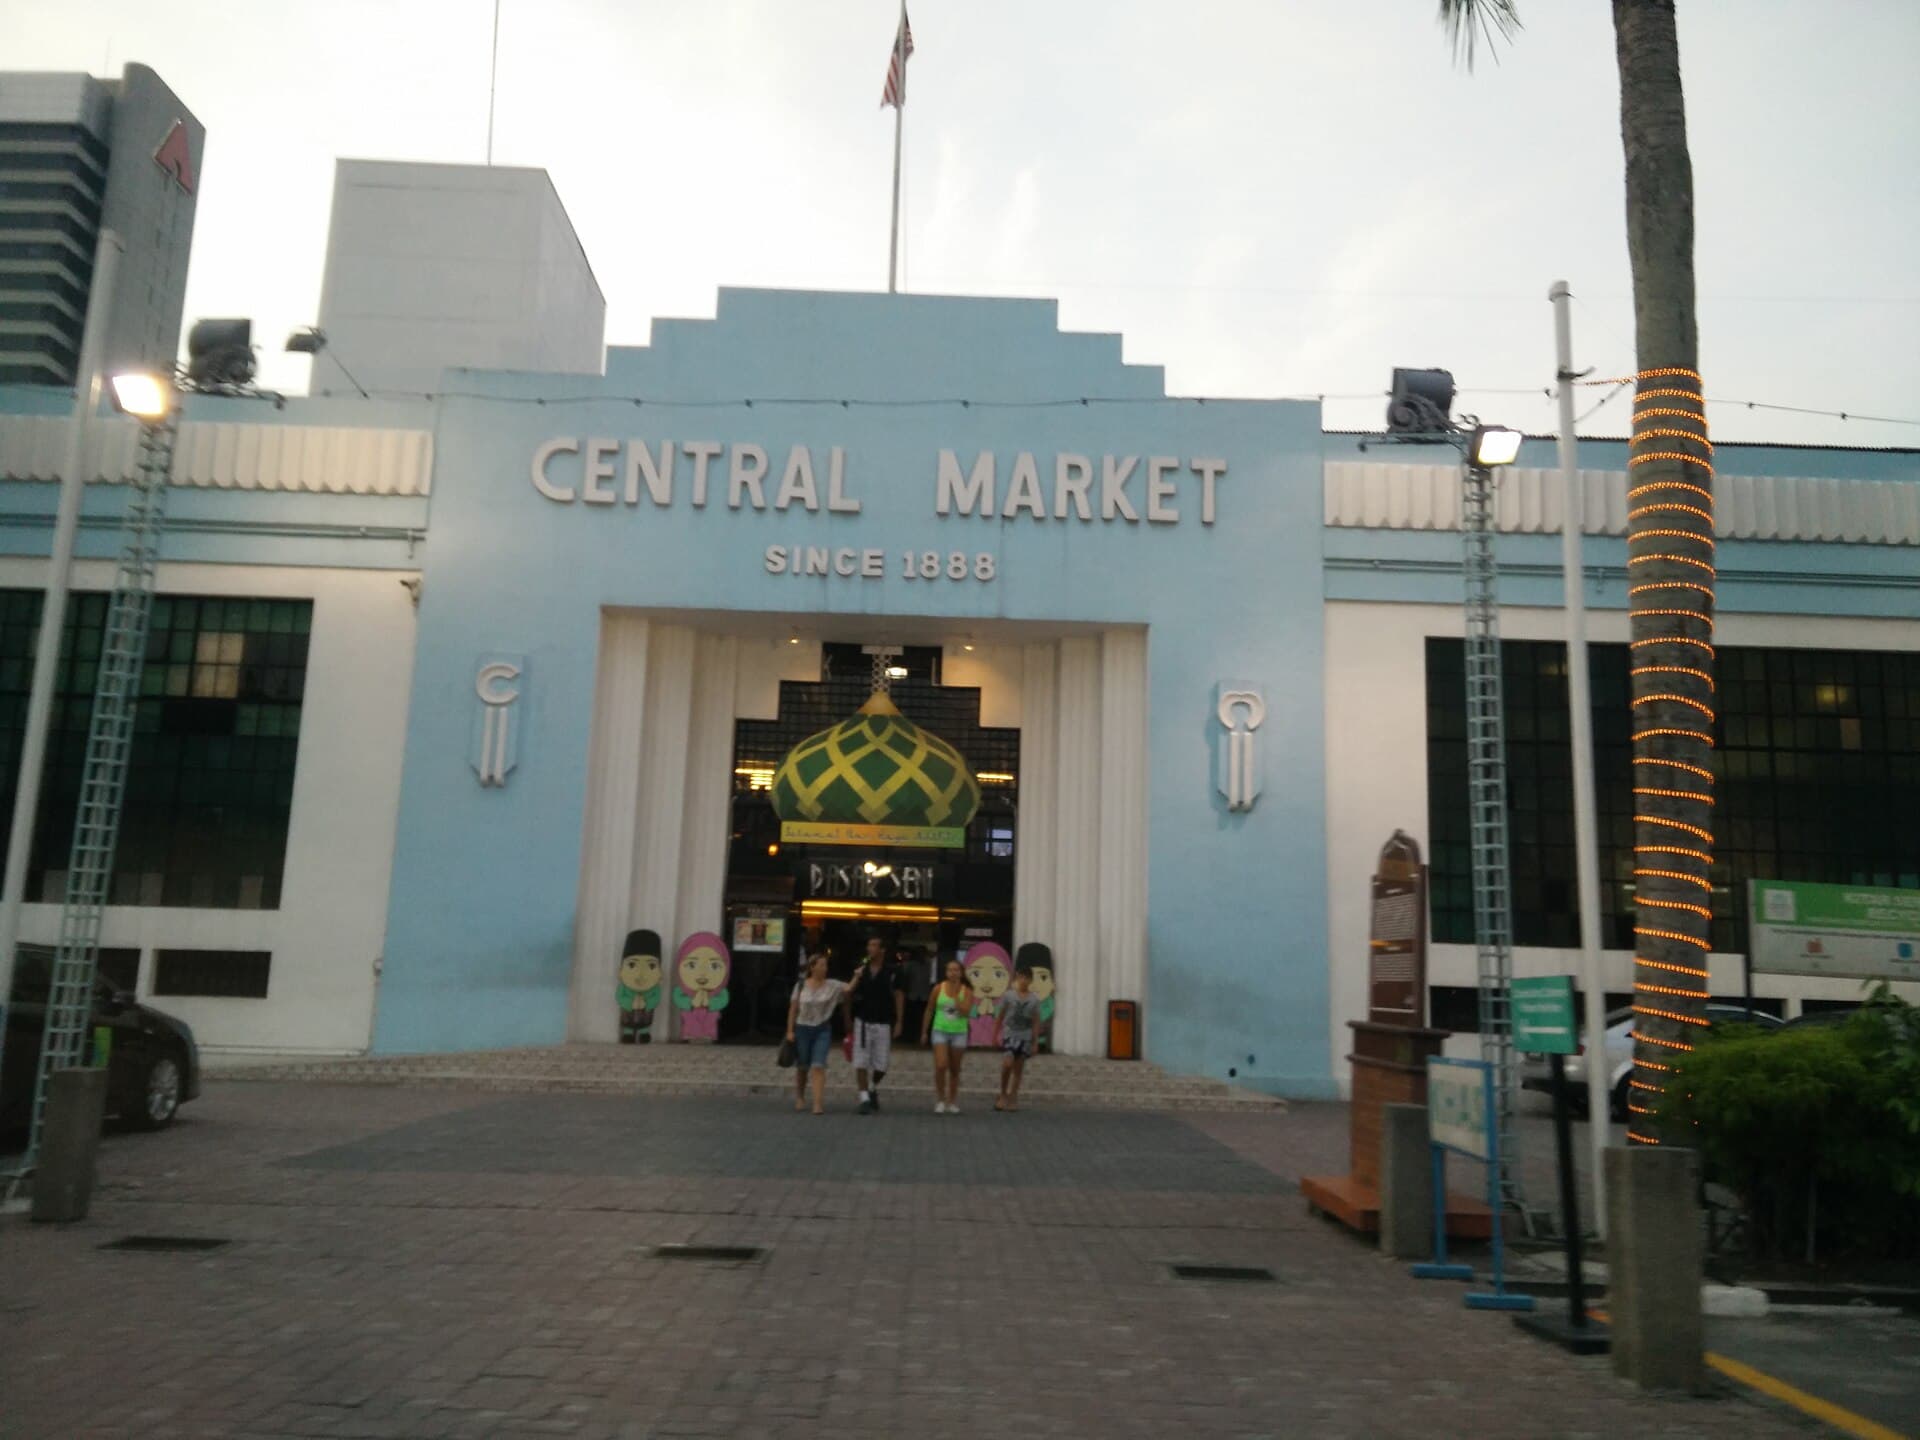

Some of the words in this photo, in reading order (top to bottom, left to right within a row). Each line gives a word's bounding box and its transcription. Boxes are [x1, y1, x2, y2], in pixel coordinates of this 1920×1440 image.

[530, 436, 862, 512] CENTRAL
[935, 448, 1227, 524] MARKET
[765, 545, 884, 577] SINCE
[902, 550, 995, 581] 1888
